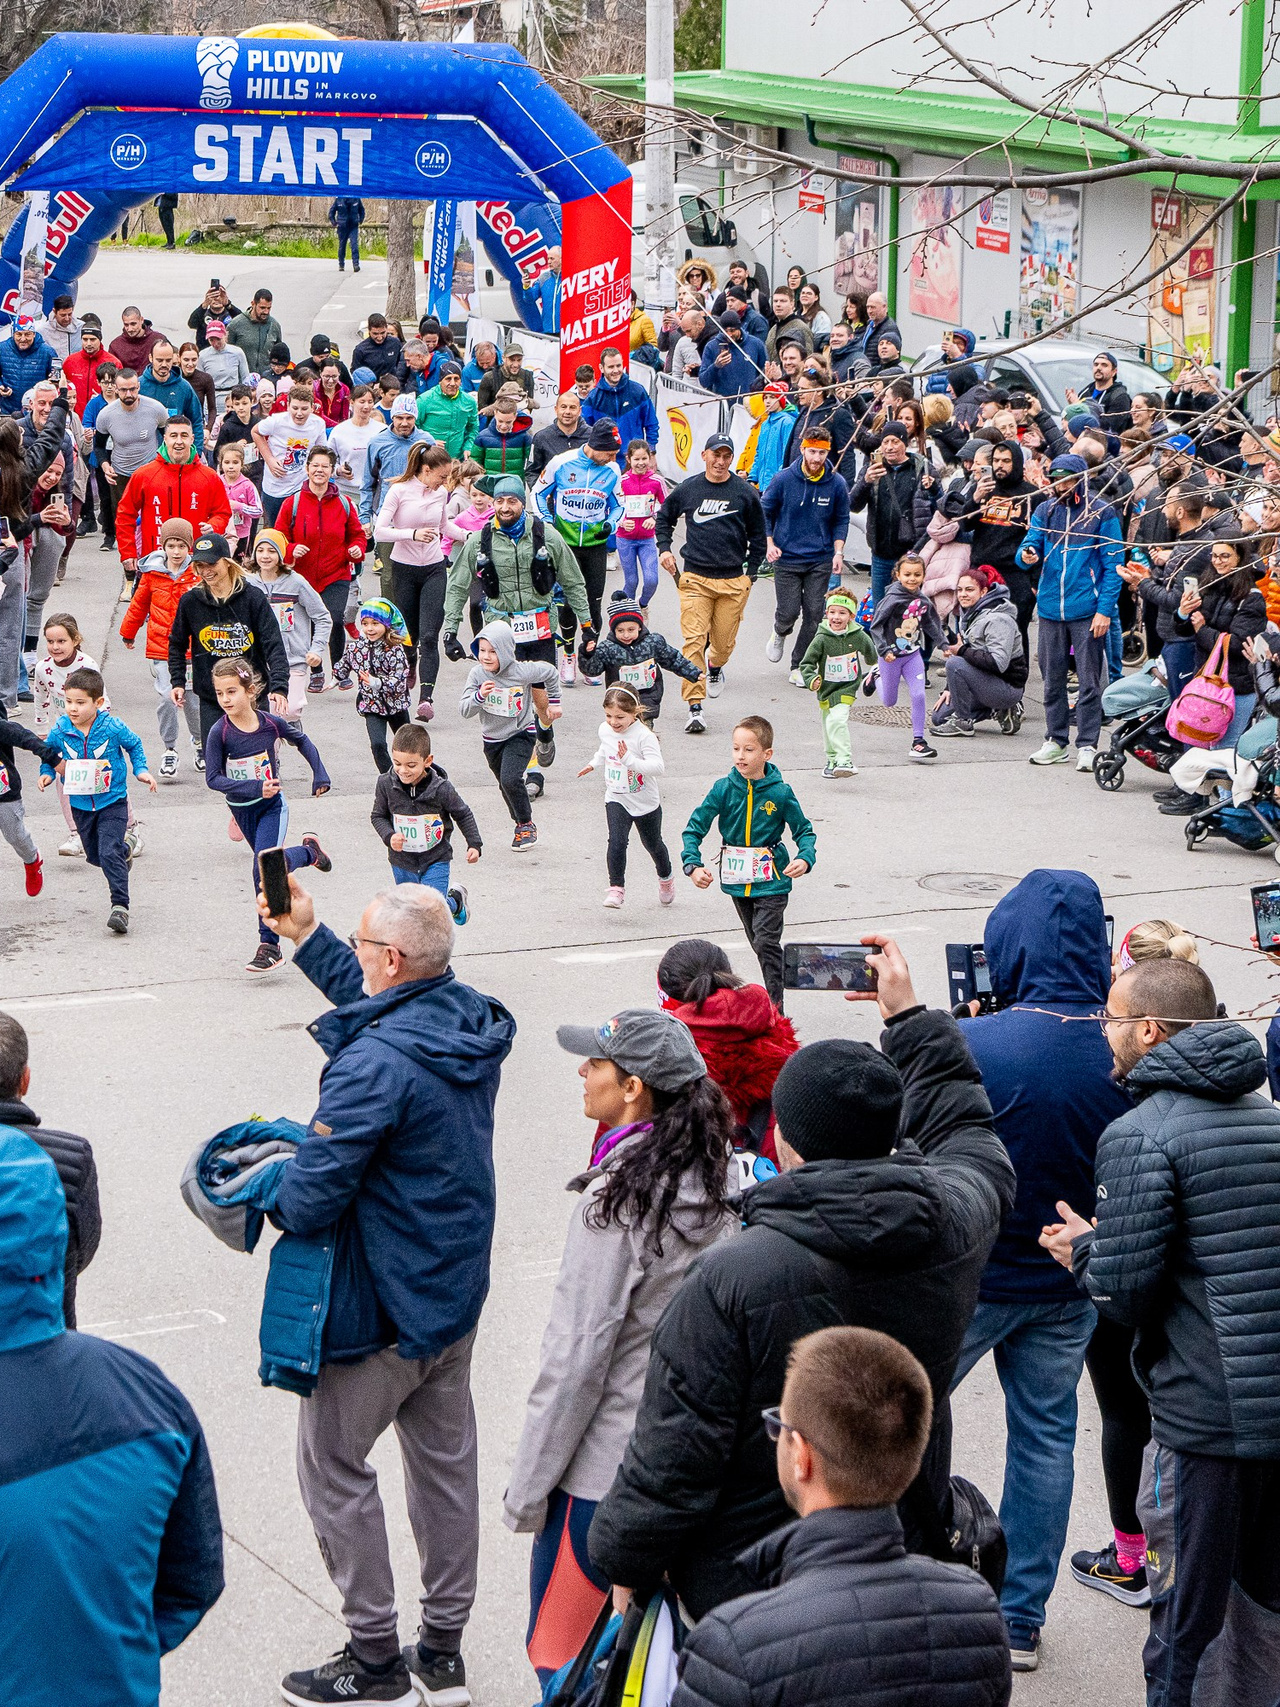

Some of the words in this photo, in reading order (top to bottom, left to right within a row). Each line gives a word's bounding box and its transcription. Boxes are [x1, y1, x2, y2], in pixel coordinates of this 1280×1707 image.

[247, 50, 343, 74] PLOVDIV
[246, 78, 309, 100] HILLS
[315, 82, 329, 90] IN
[315, 92, 377, 100] MARKOVO
[192, 123, 372, 185] START
[561, 257, 619, 303] EVERY
[699, 499, 730, 513] NIKE
[513, 621, 535, 633] 2318
[214, 638, 250, 650] PARK
[828, 664, 842, 673] 130
[625, 672, 640, 681] 179
[487, 694, 502, 705] 186
[70, 769, 88, 781] 187
[229, 769, 248, 780] 125
[608, 768, 621, 781] 147
[727, 858, 745, 871] 177
